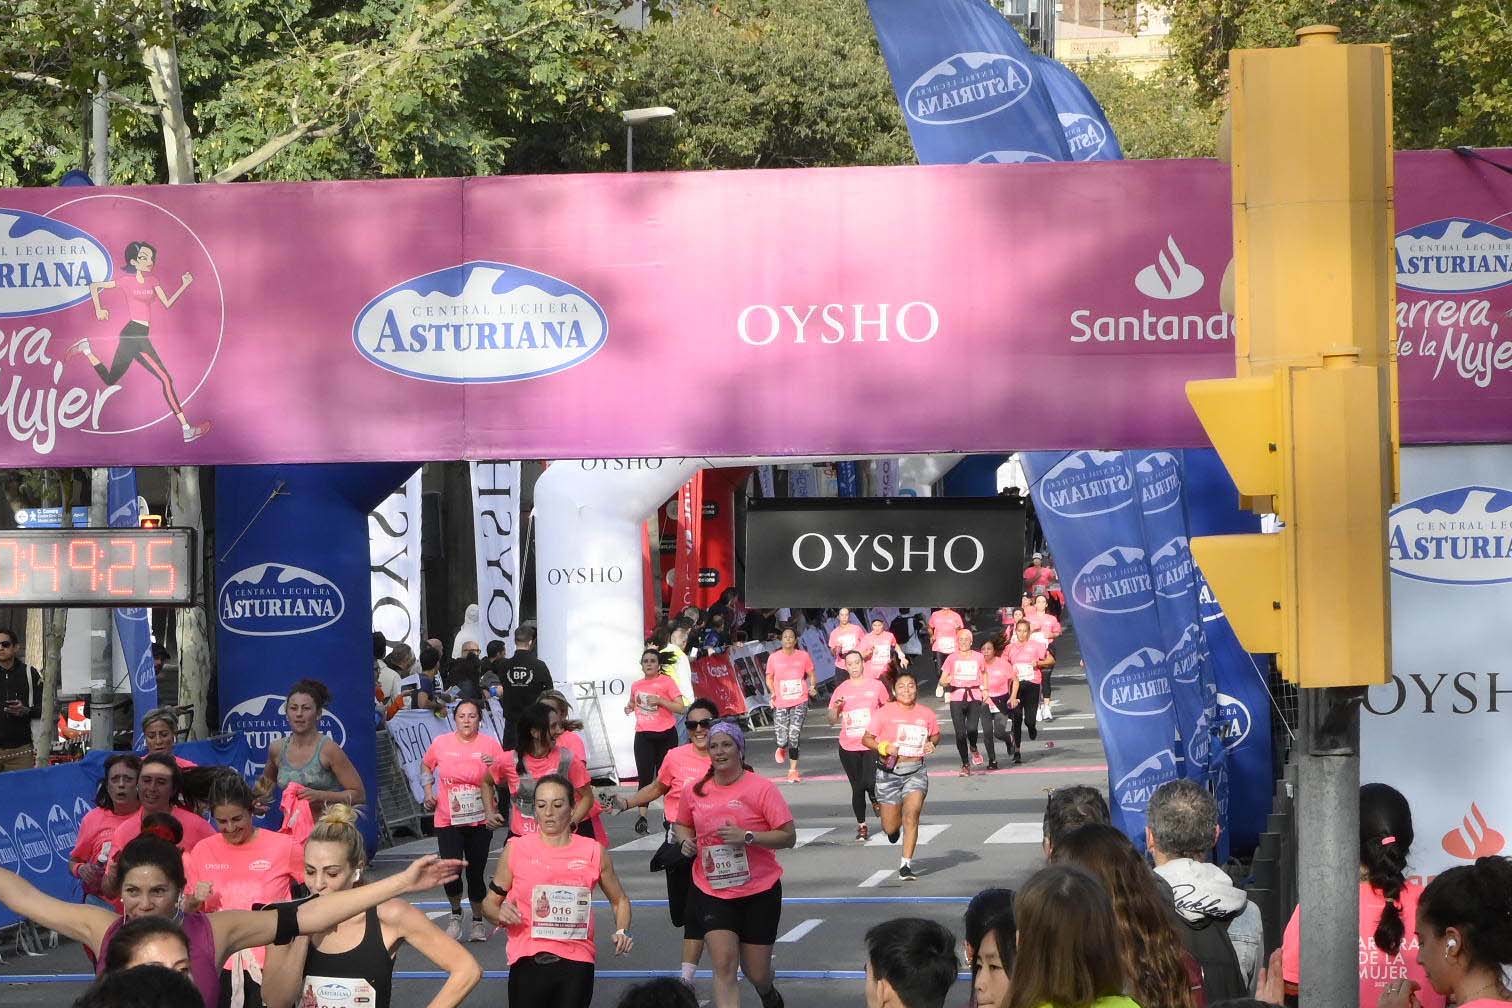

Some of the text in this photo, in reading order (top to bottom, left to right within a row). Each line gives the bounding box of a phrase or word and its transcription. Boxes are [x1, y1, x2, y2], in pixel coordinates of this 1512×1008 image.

[16, 244, 87, 256] LECHERA
[1409, 242, 1461, 253] CENTRAL
[412, 302, 581, 317] CENTRAL LECHERA
[1395, 299, 1491, 328] arrera
[373, 308, 589, 353] ASTURIANA
[737, 301, 940, 347] OYSHO
[1416, 521, 1485, 531] CENTRAL
[791, 532, 986, 574] OYSHO
[547, 565, 623, 585] OYSHO
[235, 587, 331, 597] CENTRAL LECHERA
[223, 592, 336, 620] ASTURIANA
[513, 671, 527, 680] BP
[552, 906, 572, 915] 016
[1359, 937, 1420, 951] ARRA
[1359, 951, 1405, 965] DE LA
[1359, 966, 1408, 980] MUJER
